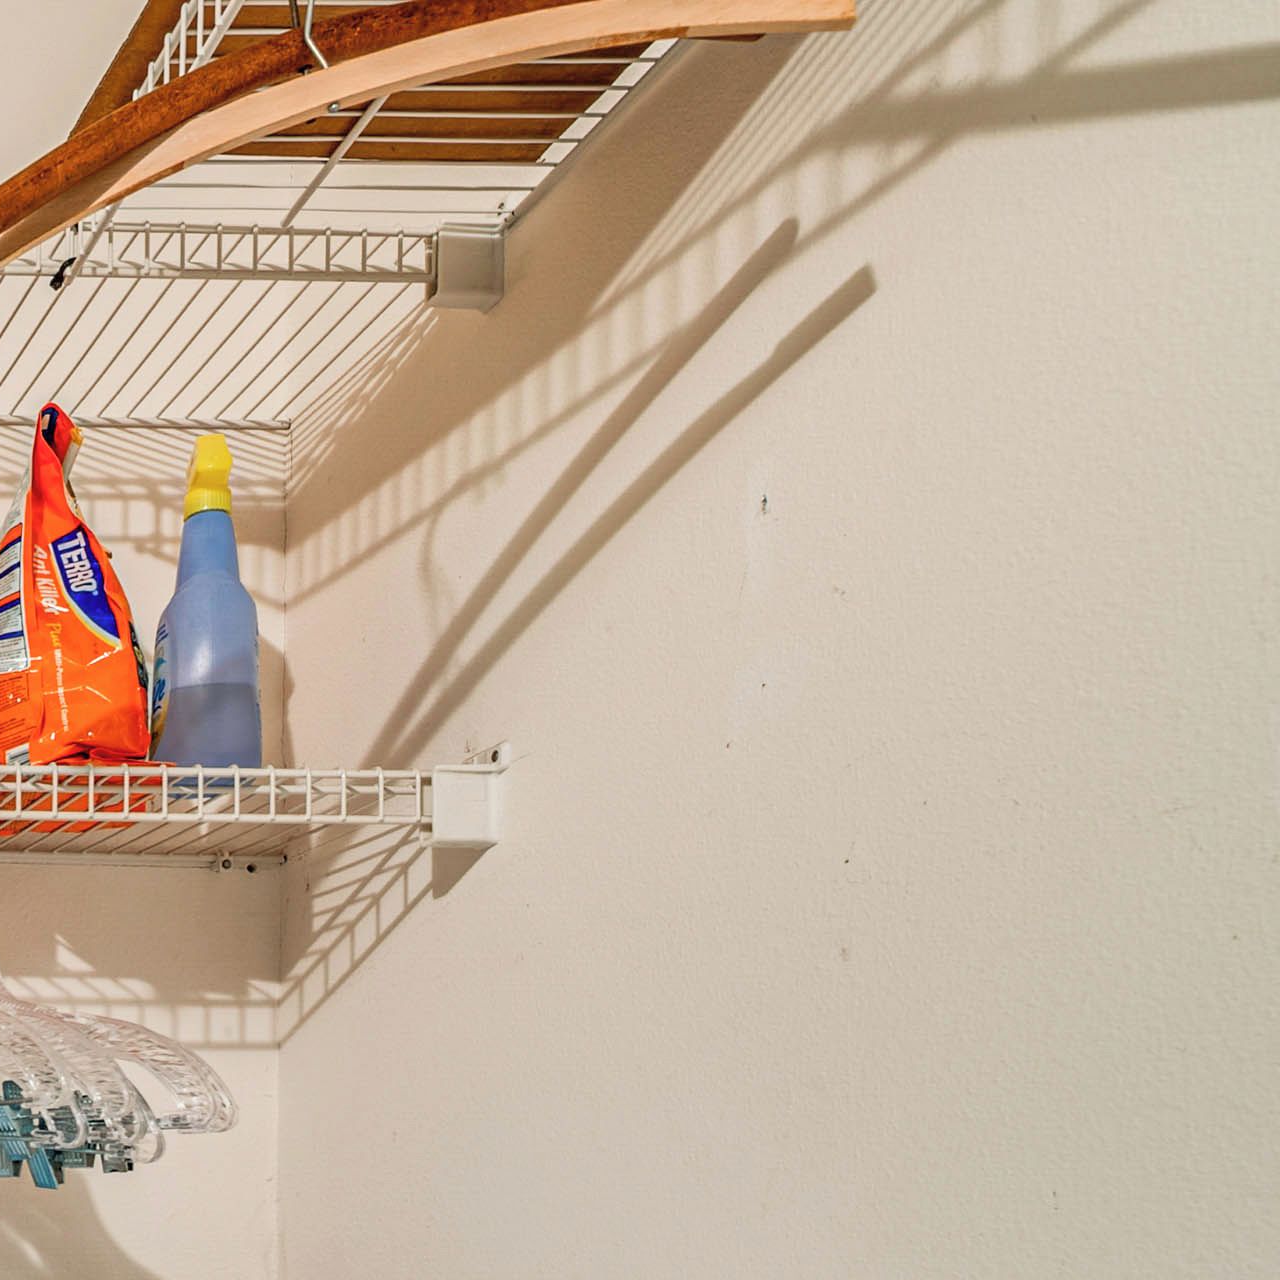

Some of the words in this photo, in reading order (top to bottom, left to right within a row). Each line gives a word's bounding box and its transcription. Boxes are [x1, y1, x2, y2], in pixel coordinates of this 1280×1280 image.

[33, 544, 51, 575] Ant
[57, 532, 97, 592] TERRO
[35, 578, 60, 615] Killer
